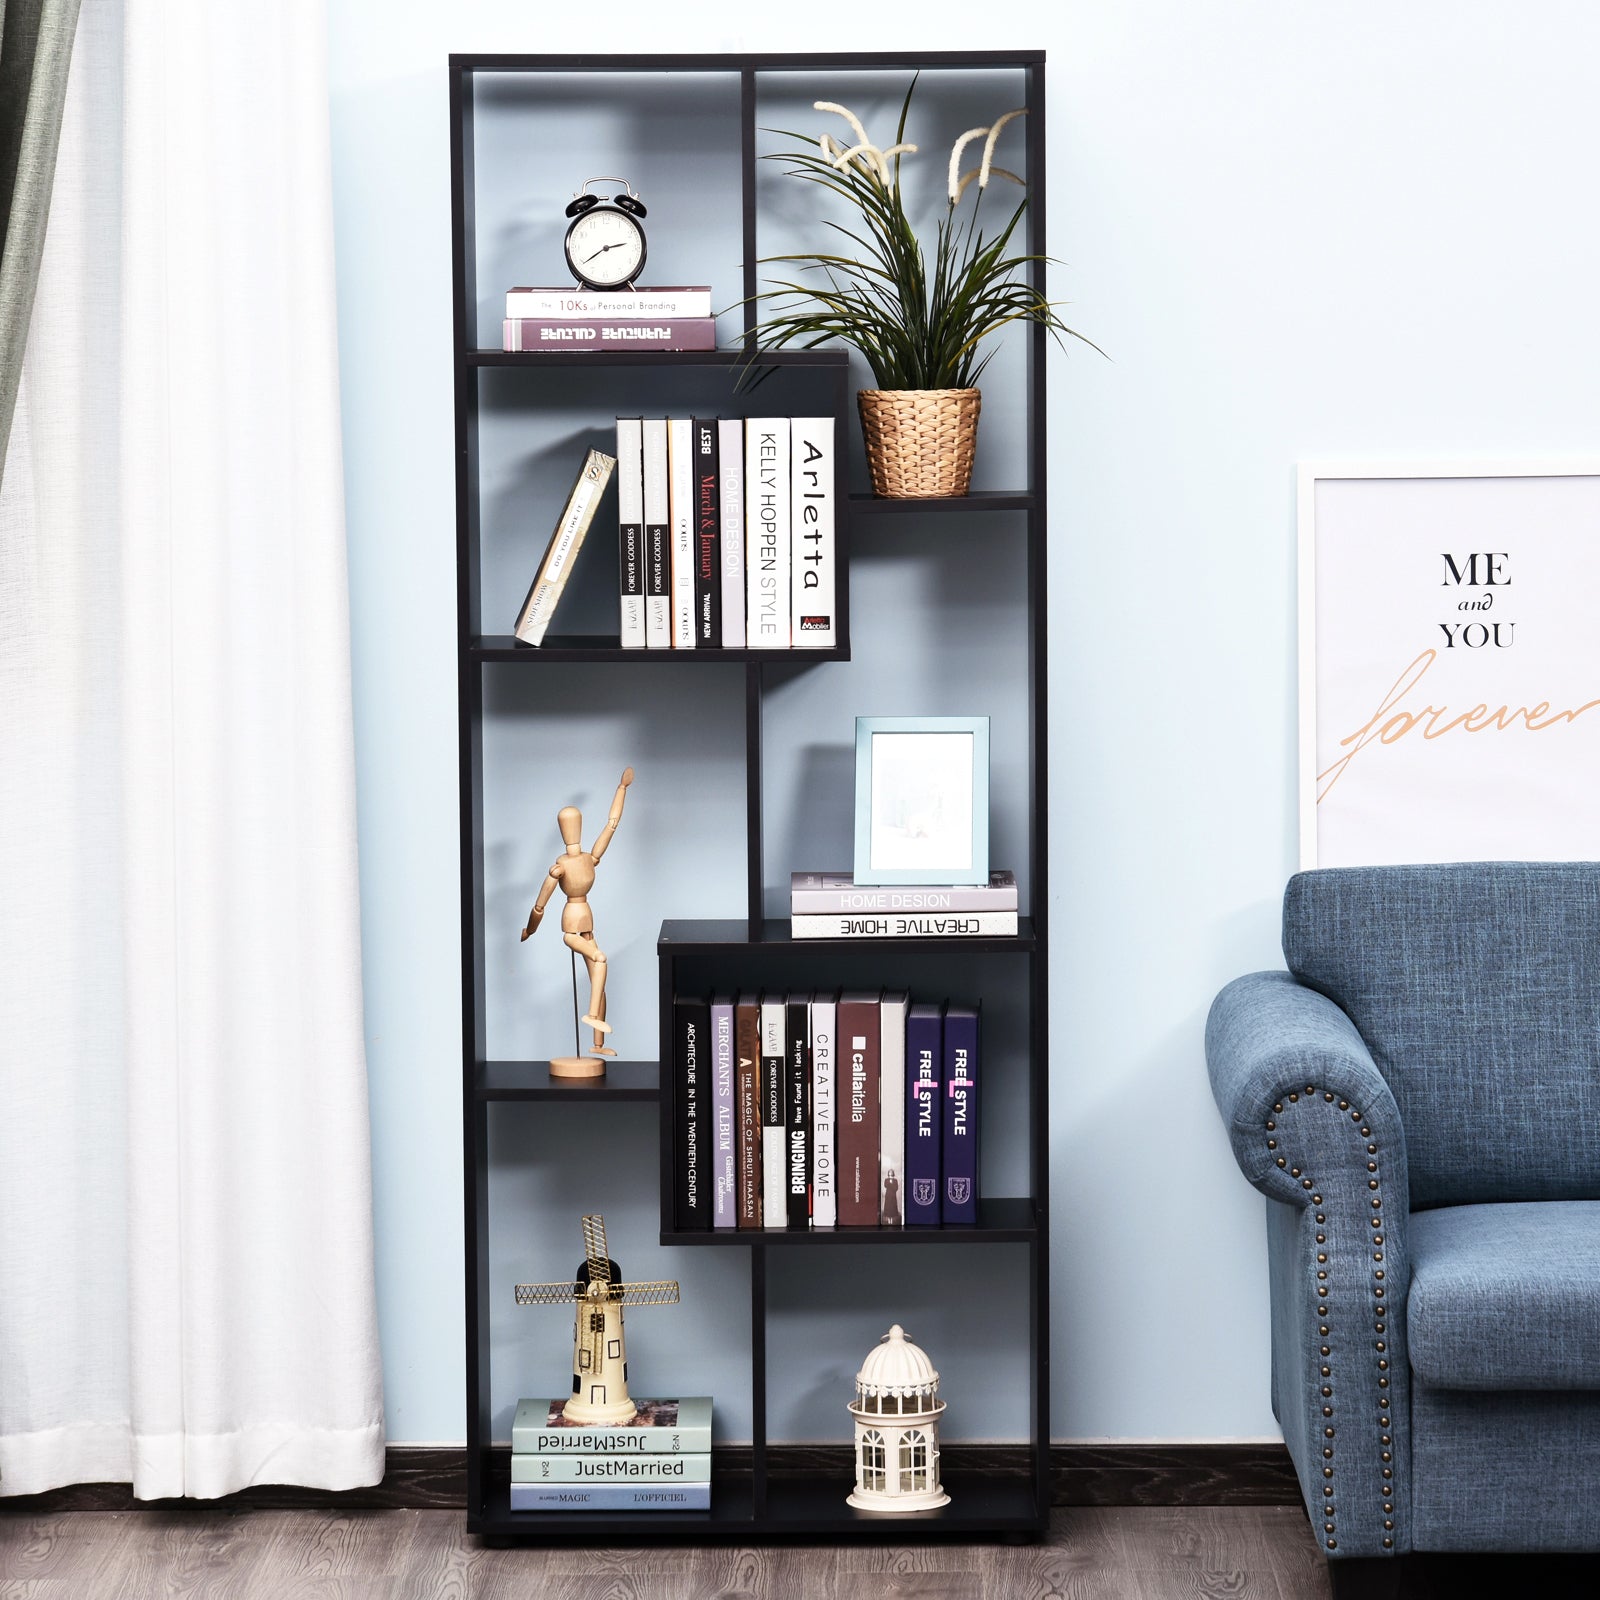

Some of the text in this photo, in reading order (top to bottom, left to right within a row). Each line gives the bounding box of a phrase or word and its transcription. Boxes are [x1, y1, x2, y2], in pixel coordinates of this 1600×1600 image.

[559, 300, 588, 311] 10Ks
[598, 301, 636, 310] Personal
[639, 302, 676, 311] Branding
[540, 328, 671, 340] FURNITURE CULTURE
[701, 427, 711, 454] BEST
[725, 467, 739, 512] HOME
[699, 475, 715, 580] March & January
[803, 440, 825, 589] Arletta
[554, 504, 583, 567] DO YOU LIKE IT
[653, 528, 661, 560] GODDESS
[760, 433, 776, 634] KELLY HOPPEN STYLE
[1440, 553, 1512, 586] ME
[527, 584, 548, 624] SIDESHOW
[703, 593, 711, 618] ARRIVAL
[1458, 593, 1493, 611] and
[1438, 623, 1516, 648] YOU
[1317, 649, 1600, 805] forever
[840, 895, 887, 908] HOME
[841, 919, 980, 934] CREATIVE HOME
[795, 1040, 803, 1067] lacking
[718, 1016, 731, 1150] MERCHANTS ALBUM
[852, 1053, 866, 1123] caliaitalia
[919, 1050, 932, 1136] FREE STYLE
[954, 1049, 967, 1135] FREE STYLE
[687, 1022, 697, 1208] ARCHITECTURE IN THE TWENTIETH CENTURY
[816, 1034, 829, 1197] CREATIVE HOME
[746, 1129, 753, 1142] OF
[792, 1131, 805, 1194] BRINGING
[746, 1181, 754, 1218] HAASAN
[538, 1436, 647, 1450] JustMarried
[575, 1460, 684, 1475] JustMarried
[559, 1494, 590, 1502] MAGIC
